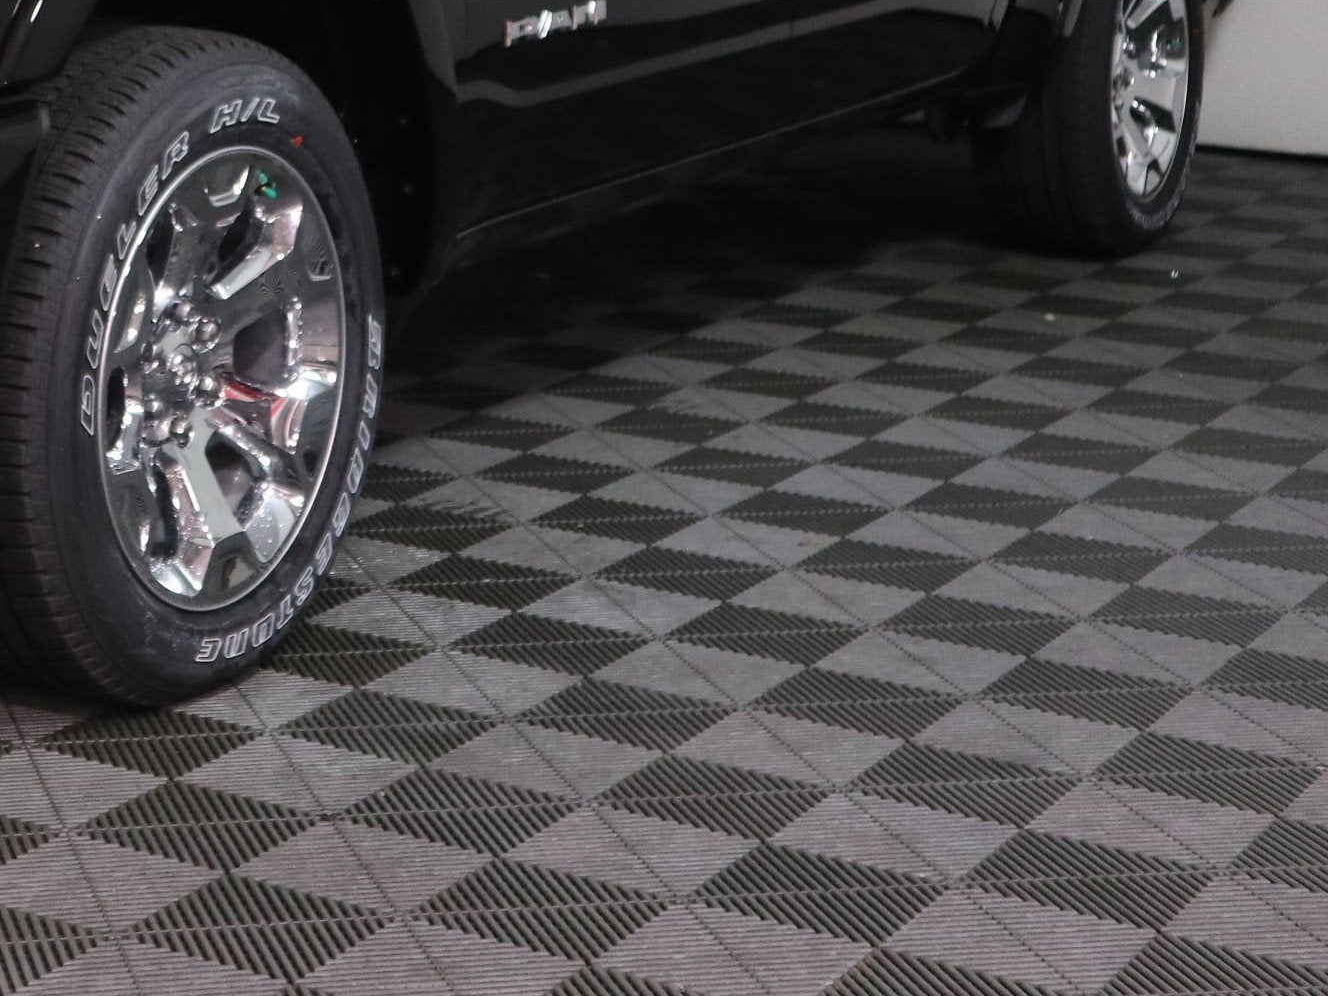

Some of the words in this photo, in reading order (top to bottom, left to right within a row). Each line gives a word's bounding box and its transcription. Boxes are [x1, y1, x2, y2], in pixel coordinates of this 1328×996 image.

[80, 130, 190, 437] DUELER
[209, 96, 281, 135] H/L
[194, 313, 383, 663] BRIDGESTONE
